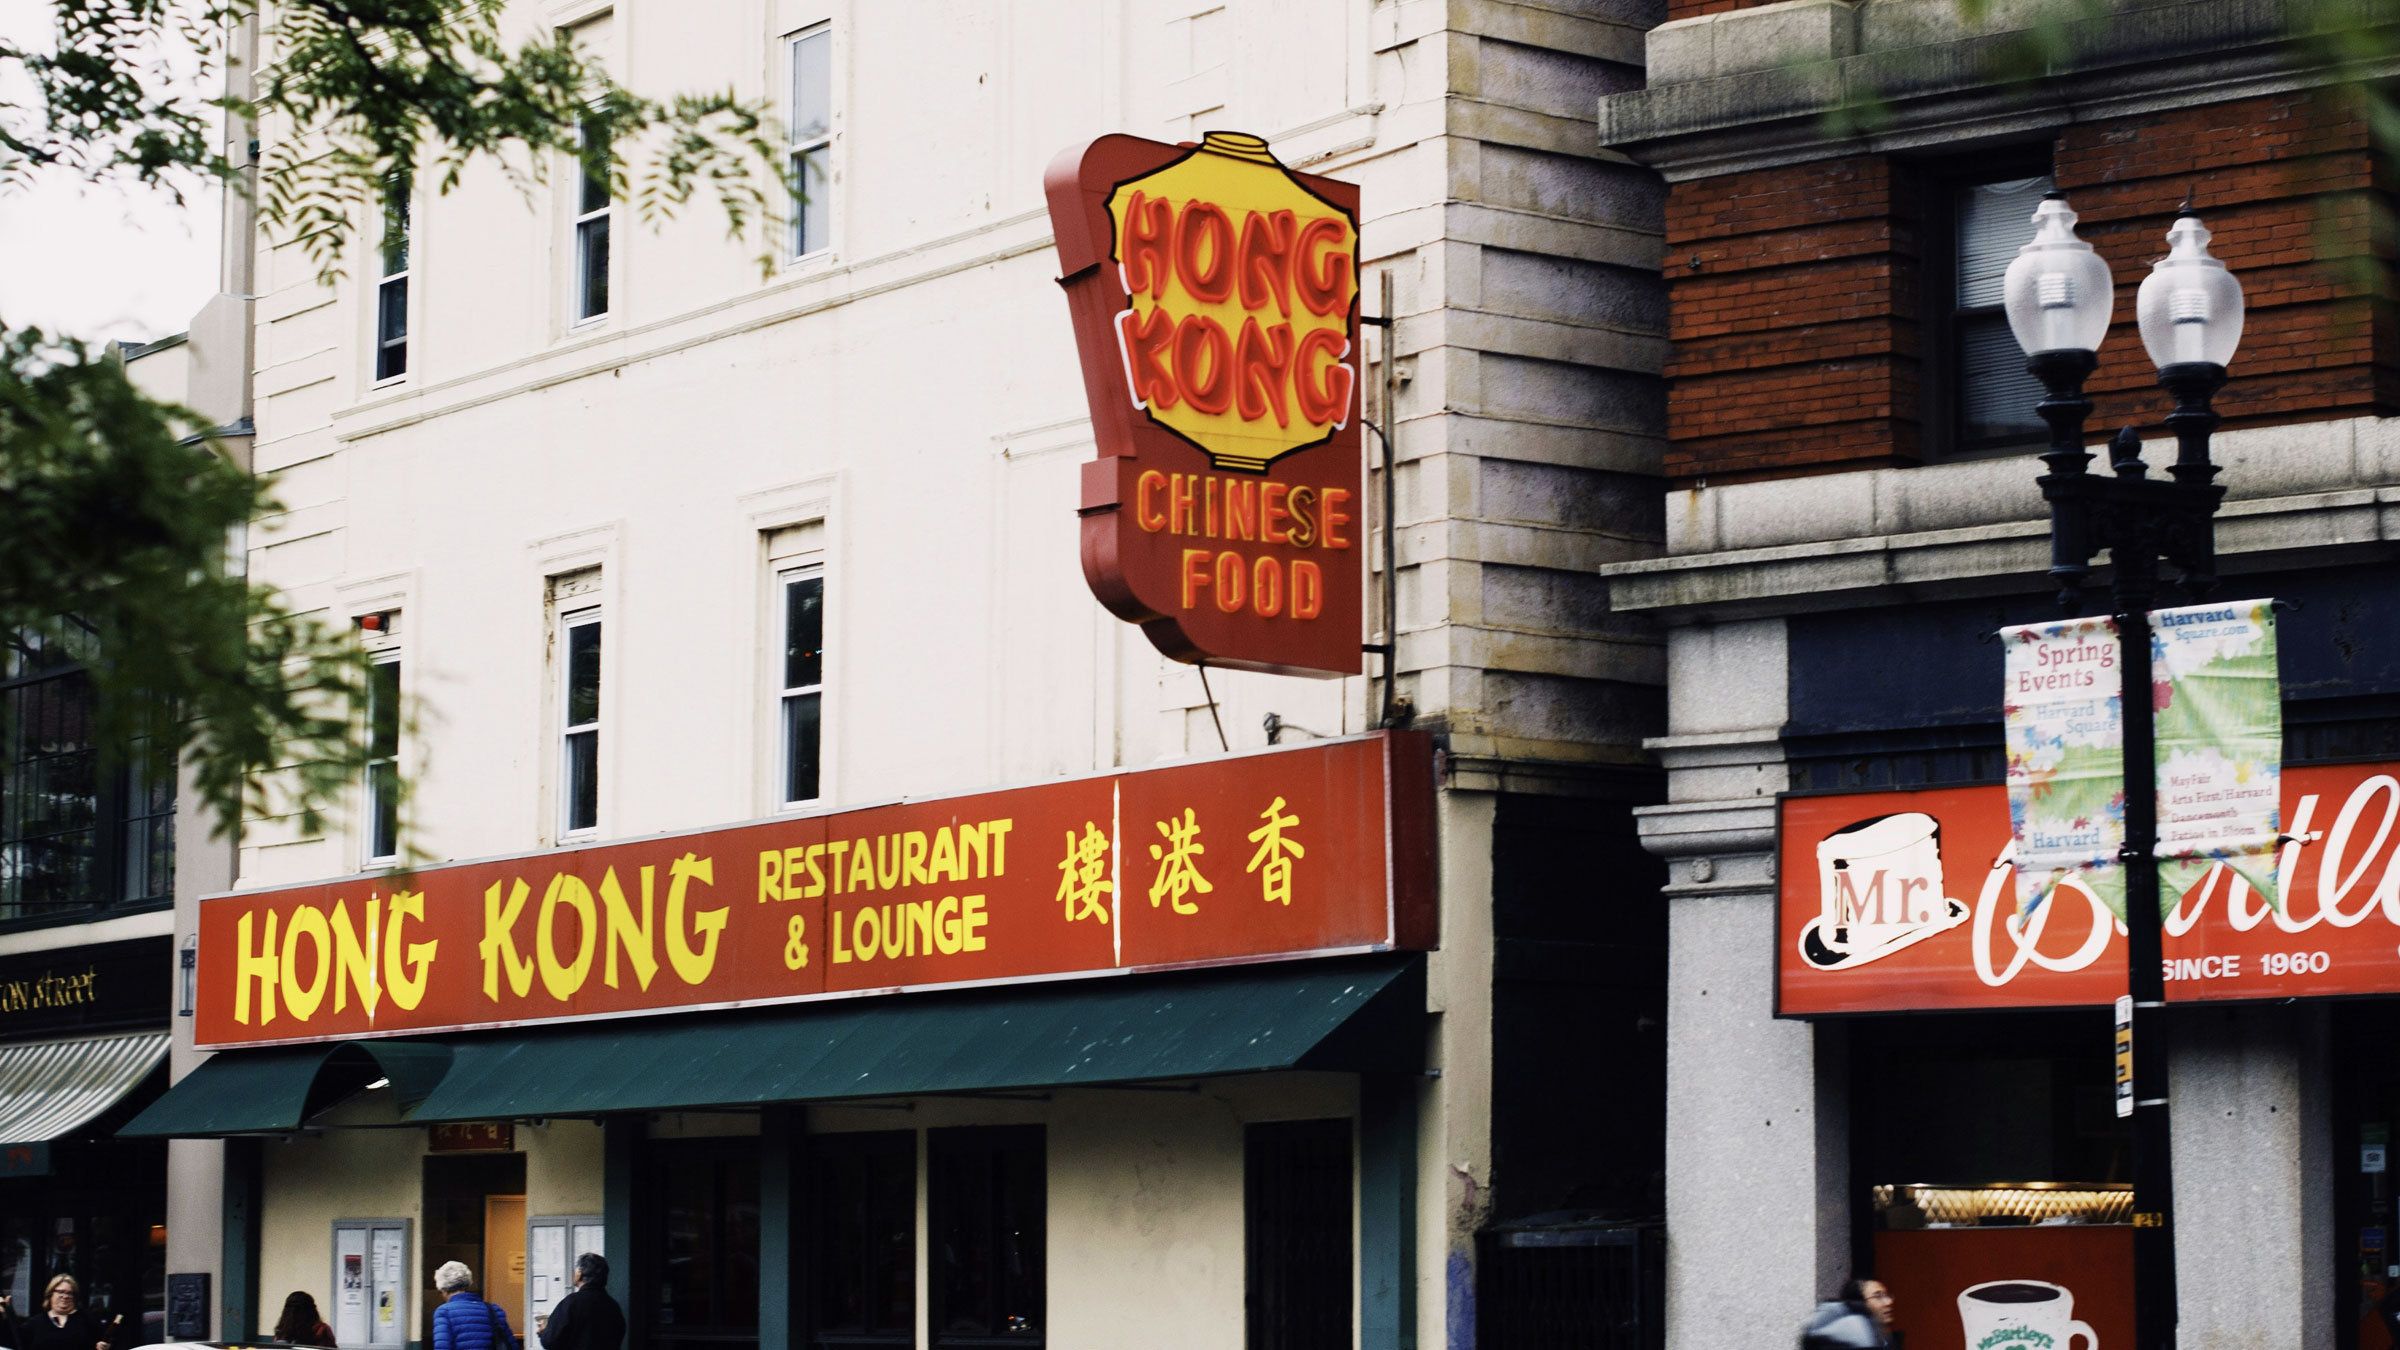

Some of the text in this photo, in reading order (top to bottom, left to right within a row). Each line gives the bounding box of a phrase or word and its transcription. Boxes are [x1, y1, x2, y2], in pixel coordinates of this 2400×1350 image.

[1121, 189, 1351, 319] HONG
[1117, 304, 1353, 430] KONG
[1137, 469, 1351, 549] CHINESE
[1182, 548, 1323, 620] FOOD
[2161, 608, 2236, 627] Harvard
[2175, 625, 2249, 644] Square.com
[2037, 641, 2115, 672] Spring
[2018, 668, 2095, 693] Events
[2036, 700, 2096, 720] Harvard
[2065, 719, 2117, 738] Square
[2171, 795, 2194, 805] Arts
[2033, 827, 2101, 849] Harvard
[2207, 828, 2219, 838] in
[758, 818, 1013, 904] RESTAURANT
[1834, 869, 1930, 927] Mr.
[234, 852, 731, 1026] HONG KONG
[784, 894, 989, 971] & LOUNGE
[2161, 951, 2331, 982] SINCE 1960
